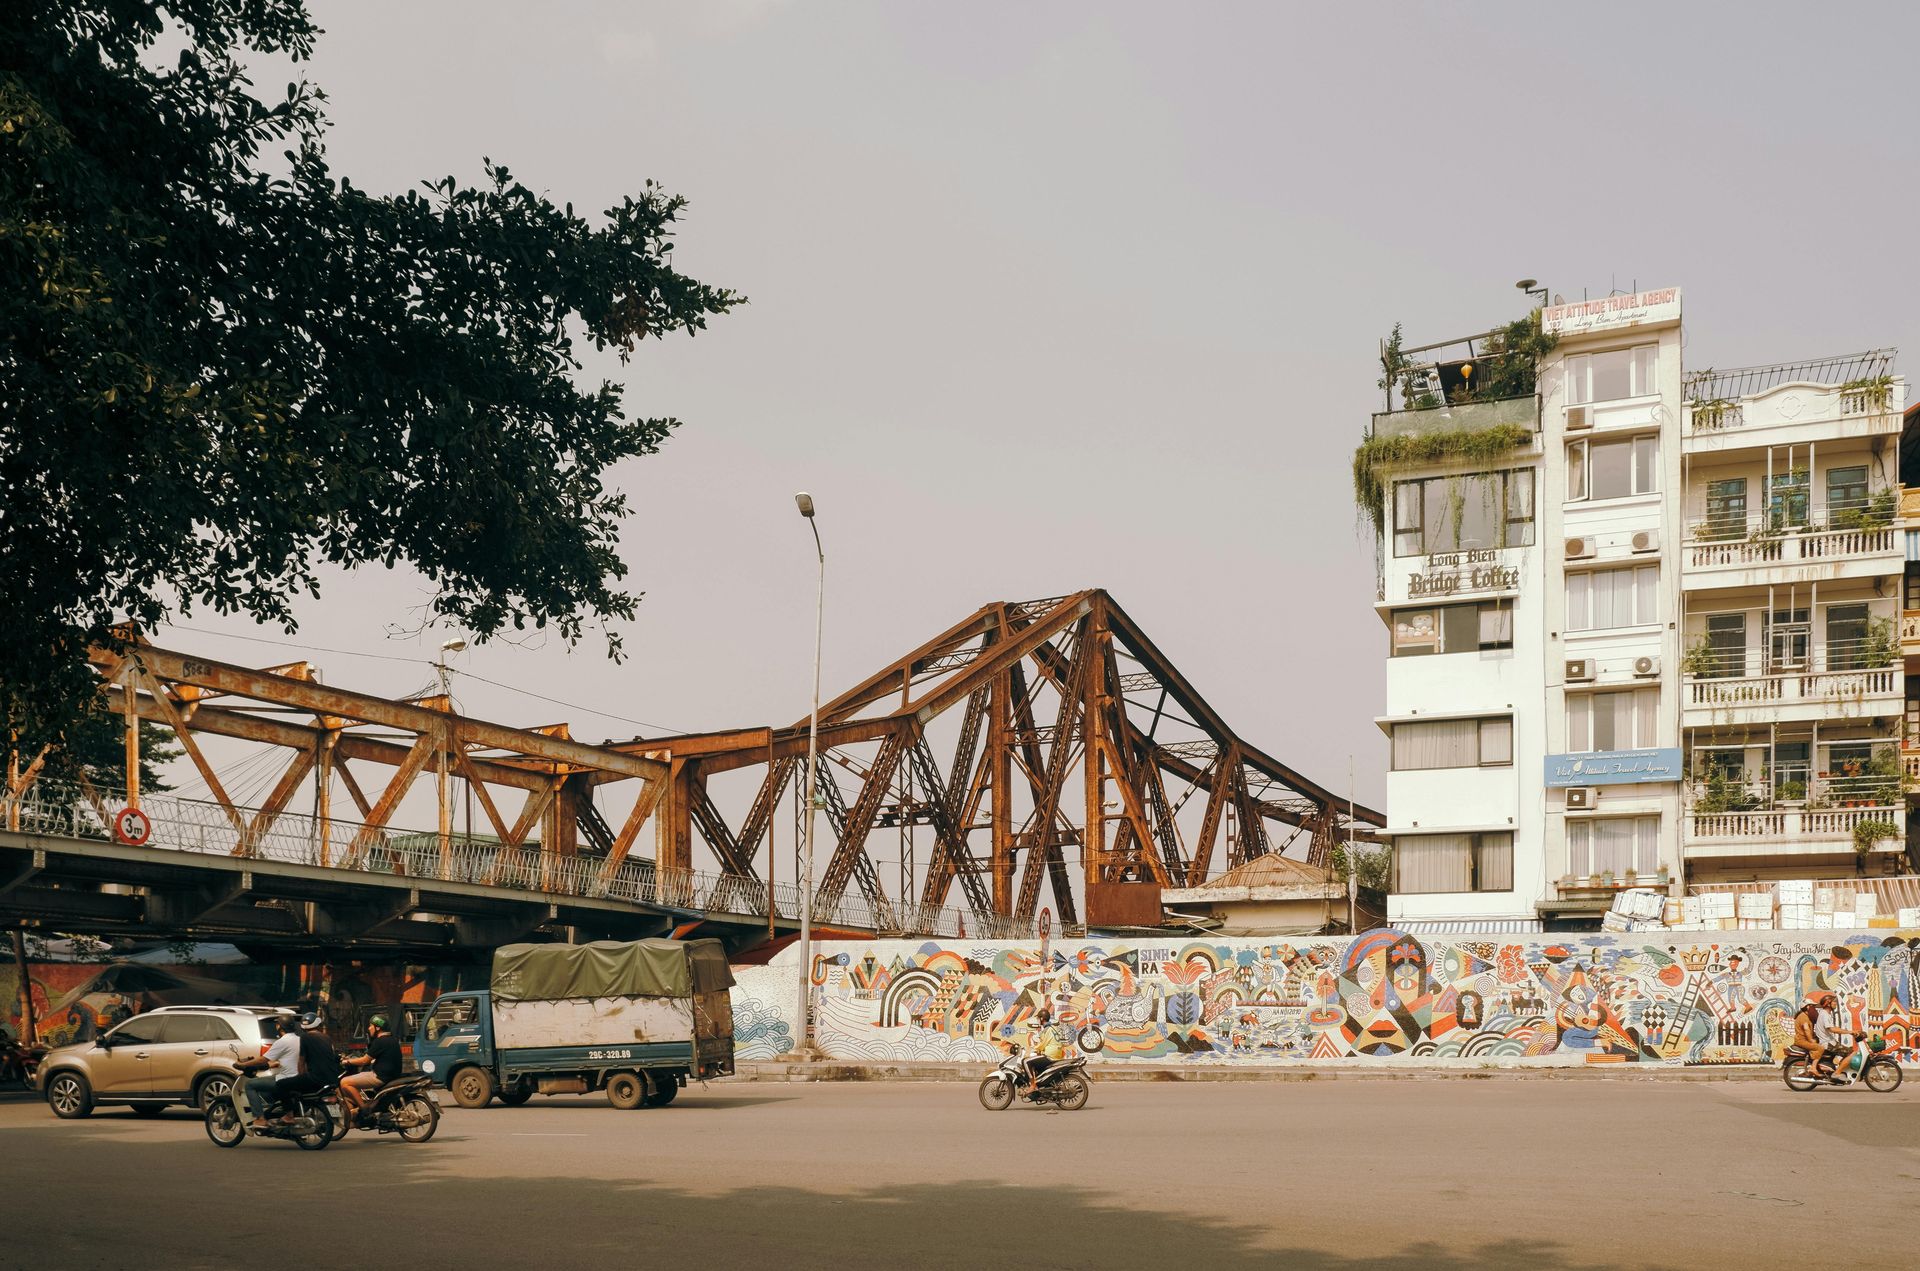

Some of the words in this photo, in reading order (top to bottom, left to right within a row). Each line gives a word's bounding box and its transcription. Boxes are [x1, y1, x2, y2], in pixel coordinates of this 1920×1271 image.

[1566, 302, 1605, 318] ATTITUDE
[1607, 295, 1639, 312] TRAVEL
[1641, 289, 1677, 307] AGENCY
[1611, 311, 1648, 323] Apartment
[1428, 552, 1460, 568] Long
[1467, 548, 1496, 563] Bien
[1408, 571, 1461, 596] Bridge
[1470, 565, 1520, 588] Coffee
[1793, 942, 1812, 954] Ban
[1812, 943, 1831, 954] Nha
[1140, 949, 1169, 961] SINH
[1141, 962, 1159, 974] RA
